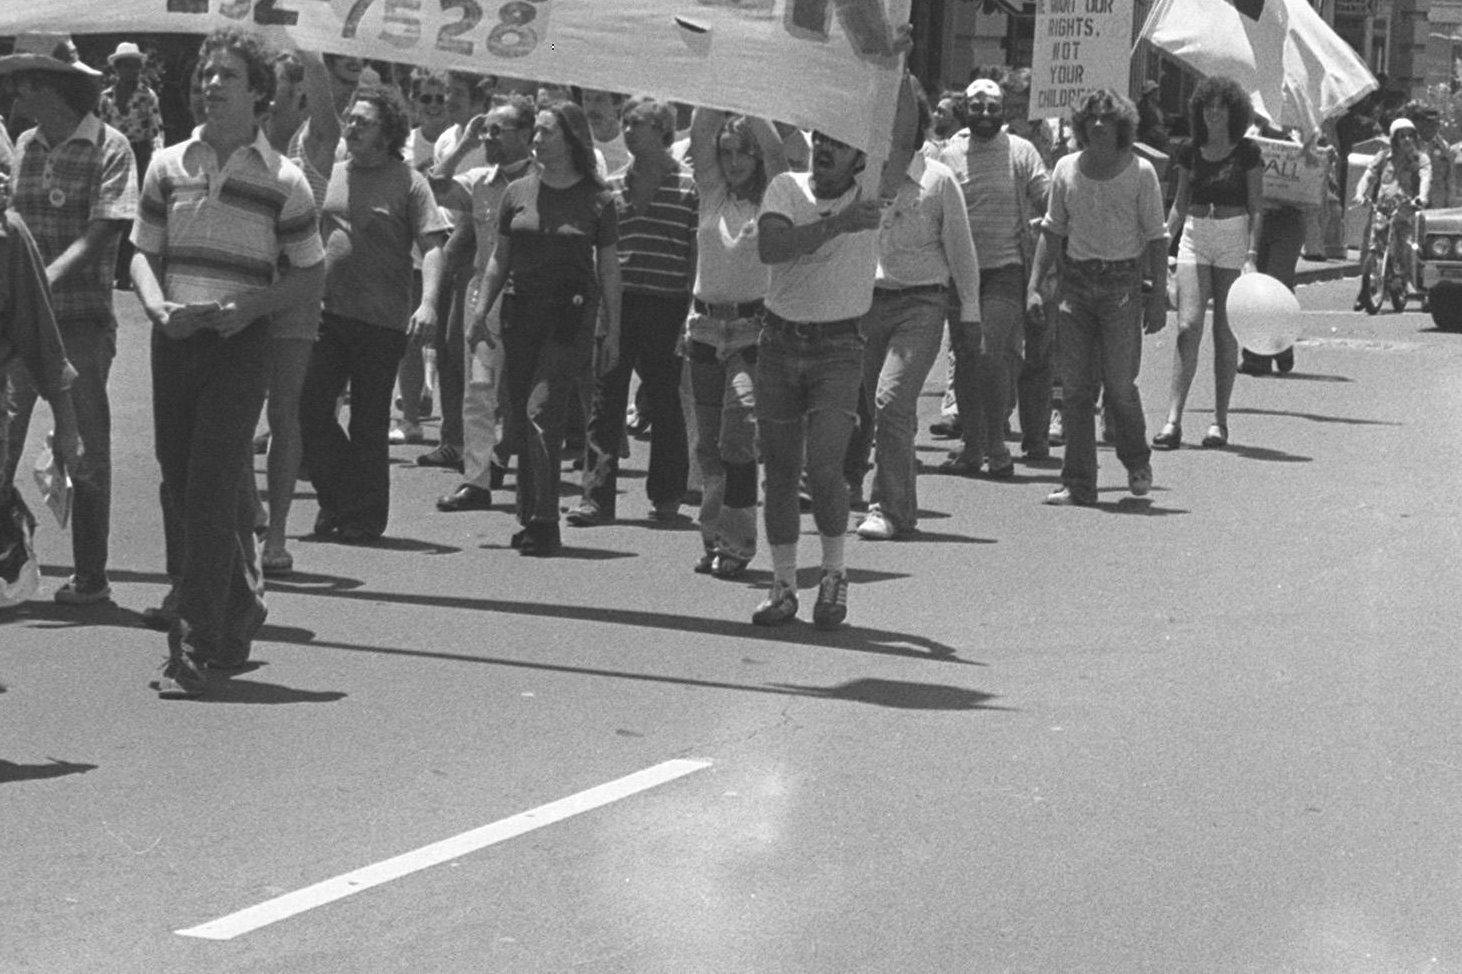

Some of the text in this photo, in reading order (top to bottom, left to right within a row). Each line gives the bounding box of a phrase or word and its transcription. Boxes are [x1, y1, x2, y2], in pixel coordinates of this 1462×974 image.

[1052, 41, 1081, 61] NOT
[1050, 64, 1084, 84] YOUR
[1038, 89, 1090, 108] CHILDR
